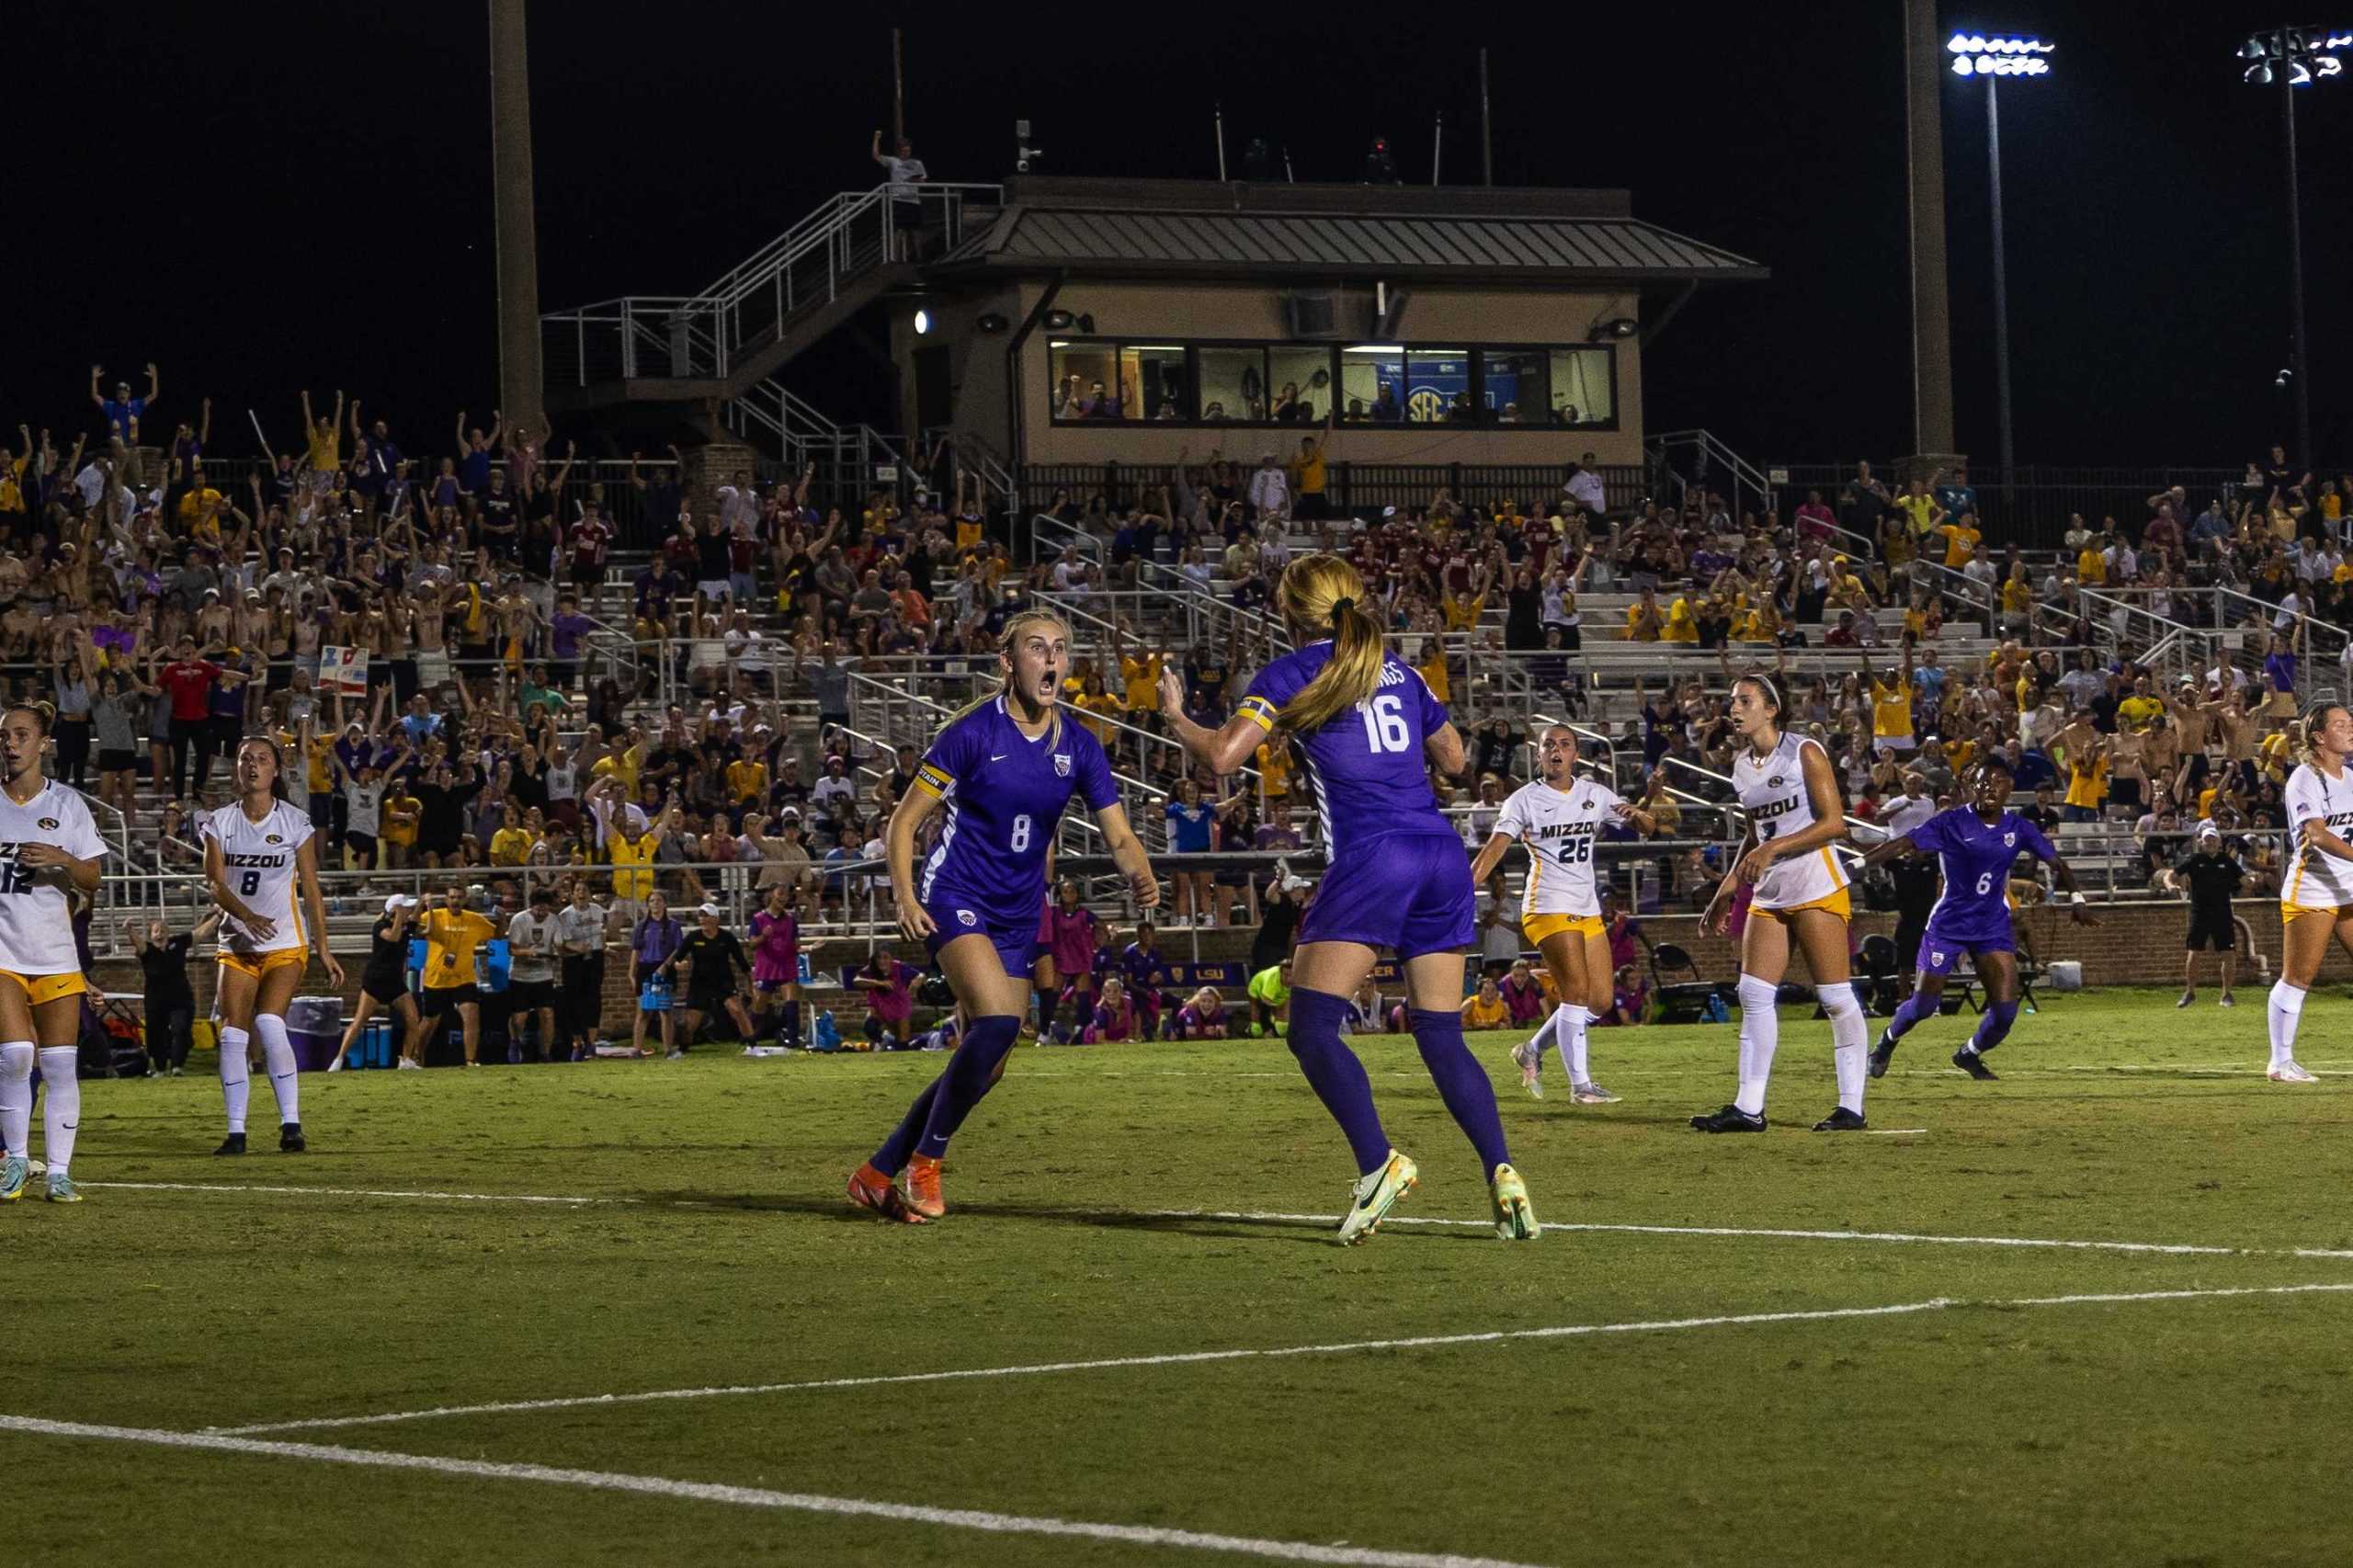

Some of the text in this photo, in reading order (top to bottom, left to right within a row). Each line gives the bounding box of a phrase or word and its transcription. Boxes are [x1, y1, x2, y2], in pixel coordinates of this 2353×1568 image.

[1356, 695, 1410, 753] 16
[1011, 814, 1030, 853] 8
[1558, 836, 1591, 864] 26
[240, 870, 261, 896] 8
[1975, 871, 1993, 895] 6
[1196, 968, 1223, 980] LSU
